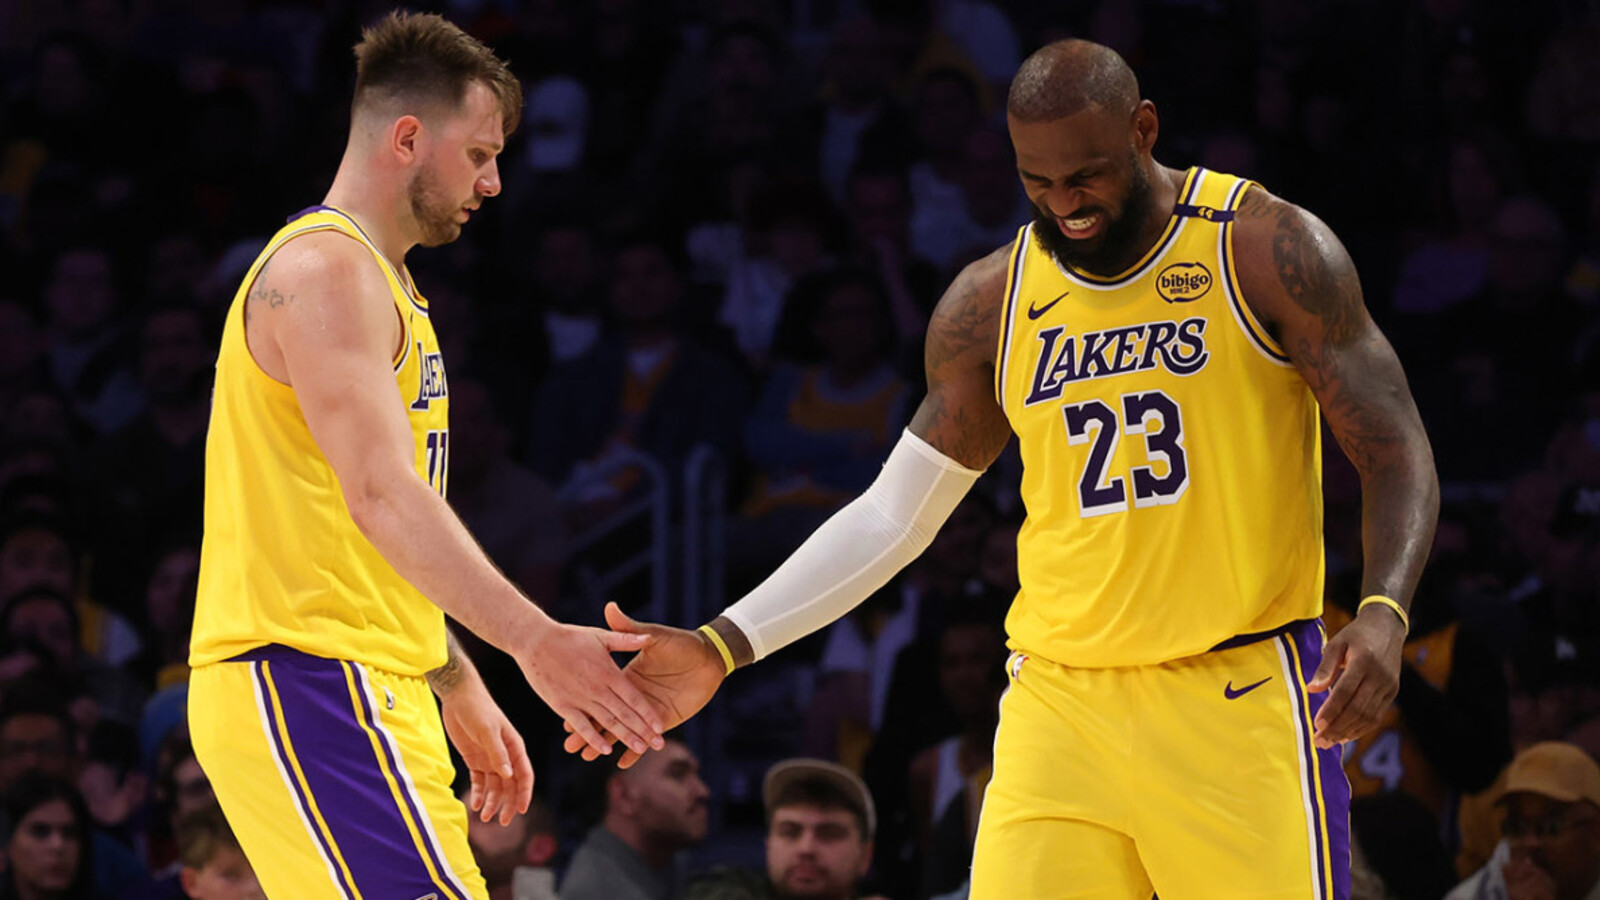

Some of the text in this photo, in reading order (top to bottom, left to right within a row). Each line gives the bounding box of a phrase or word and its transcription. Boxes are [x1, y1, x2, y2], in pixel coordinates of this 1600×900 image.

[1161, 272, 1209, 290] bibigo
[1024, 317, 1210, 407] LAKERS
[1061, 388, 1190, 518] 23
[1343, 728, 1405, 792] 4
